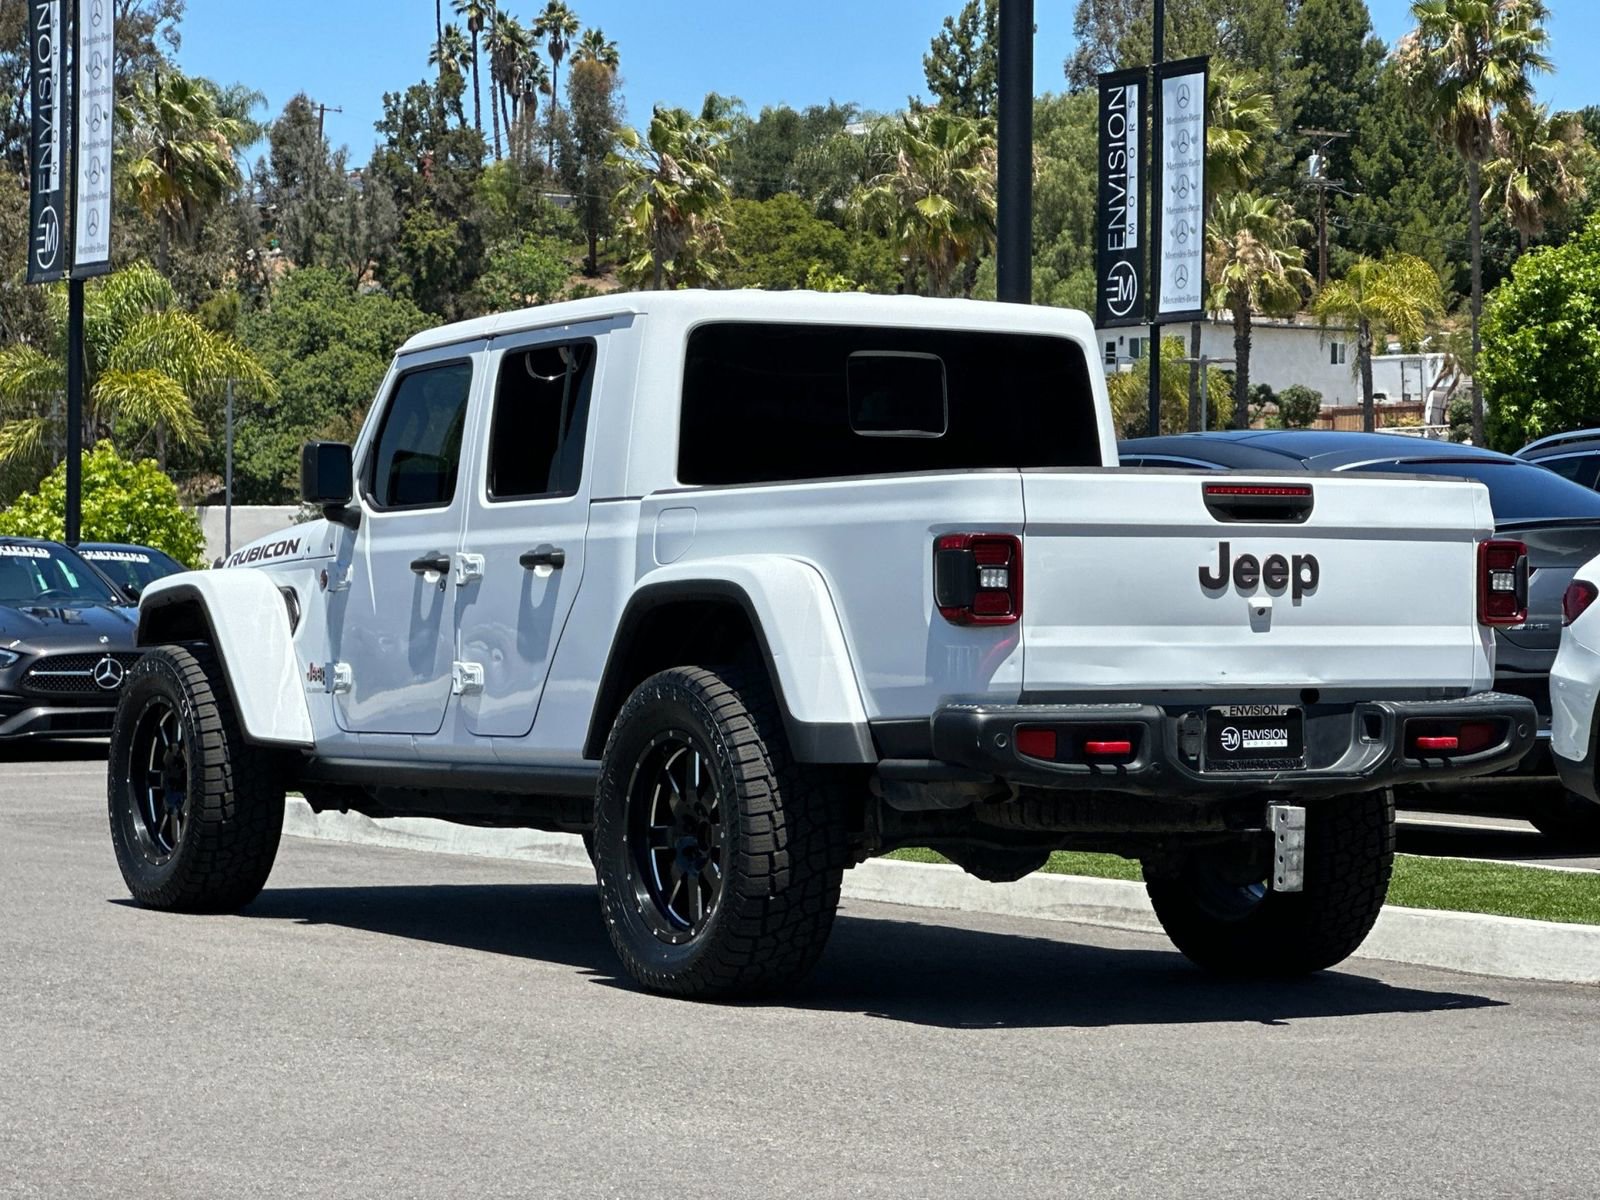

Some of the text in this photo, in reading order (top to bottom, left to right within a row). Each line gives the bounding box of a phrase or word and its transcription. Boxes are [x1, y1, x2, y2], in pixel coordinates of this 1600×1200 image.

[37, 2, 52, 194] ENVISION
[1107, 86, 1126, 250] ENVISION
[1128, 100, 1136, 236] MOTORS
[1166, 158, 1201, 171] Mercedes-Benz
[1166, 203, 1200, 215] Mercedes-Benz
[1165, 249, 1200, 259] Mercedes-Benz
[1162, 294, 1199, 305] Mercedes-Benz
[227, 538, 302, 568] RUBICON
[1198, 541, 1319, 600] Jeep
[1229, 705, 1279, 715] ENVISION
[1242, 728, 1288, 740] ENVISION
